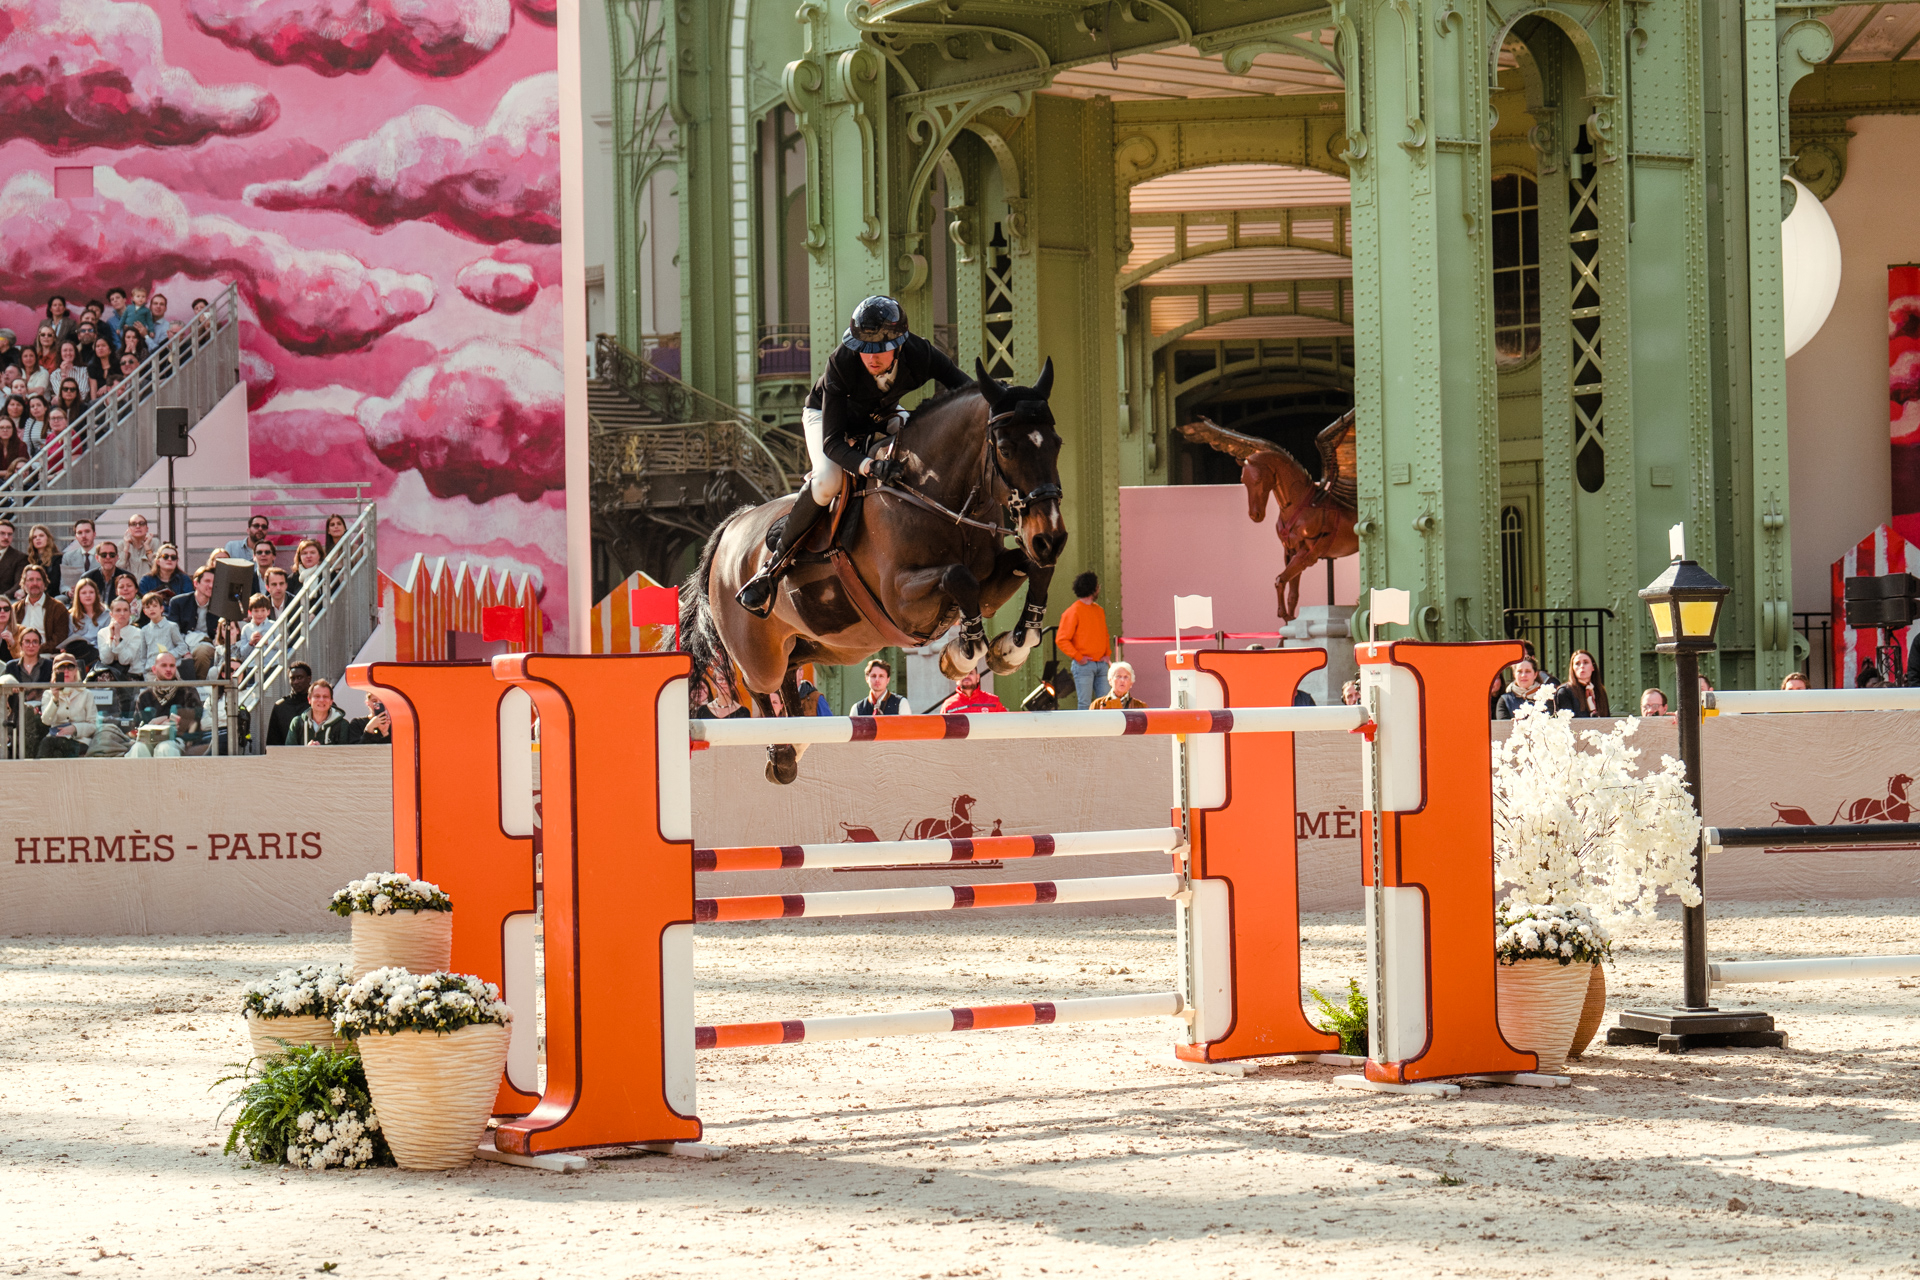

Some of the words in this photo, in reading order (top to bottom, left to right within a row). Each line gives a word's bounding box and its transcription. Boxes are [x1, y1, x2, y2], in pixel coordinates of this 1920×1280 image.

[1297, 805, 1357, 839] MÈ
[15, 830, 174, 864] HERMÈS
[208, 832, 322, 860] PARIS
